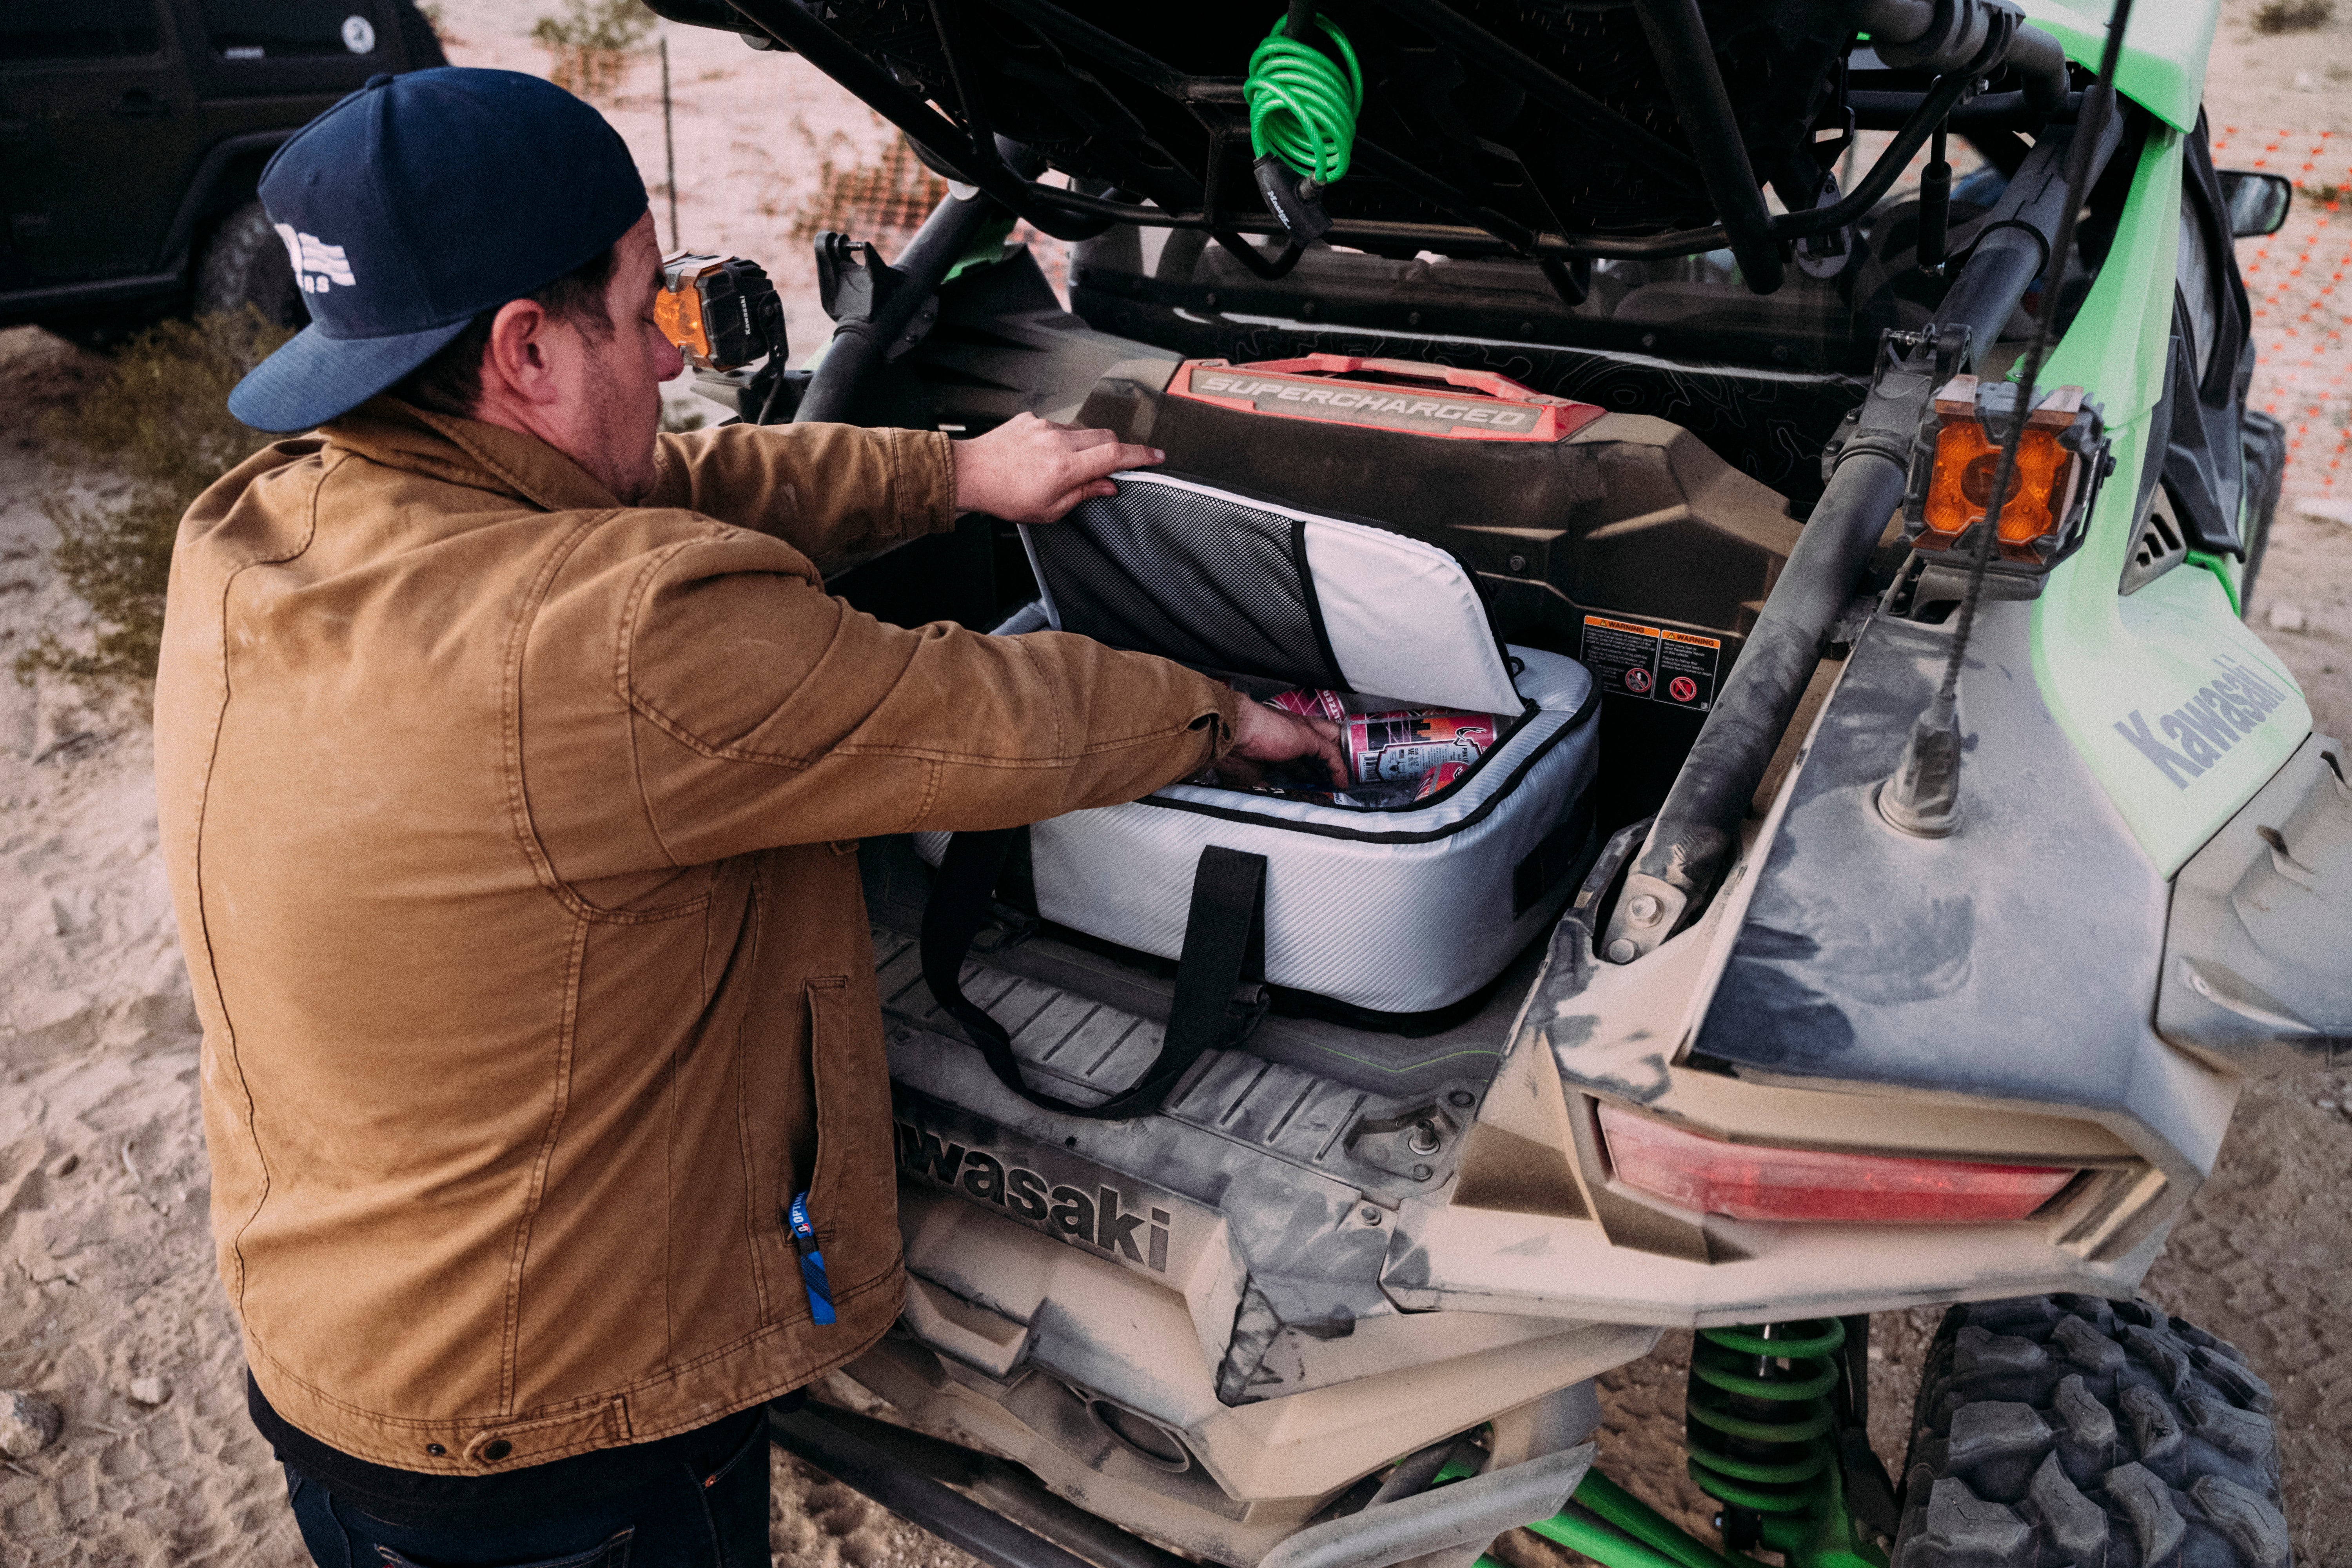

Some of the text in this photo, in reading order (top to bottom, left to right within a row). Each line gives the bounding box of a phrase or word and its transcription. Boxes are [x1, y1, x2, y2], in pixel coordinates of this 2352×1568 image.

[1267, 191, 1290, 223] Master
[739, 296, 751, 335] Kawasaki
[1200, 377, 1527, 426] SUPERCHARGED
[1609, 622, 1645, 633] WARNING
[1677, 634, 1714, 646] WARNING
[2112, 653, 2287, 790] Kawasaki
[893, 1118, 1171, 1273] wasaki
